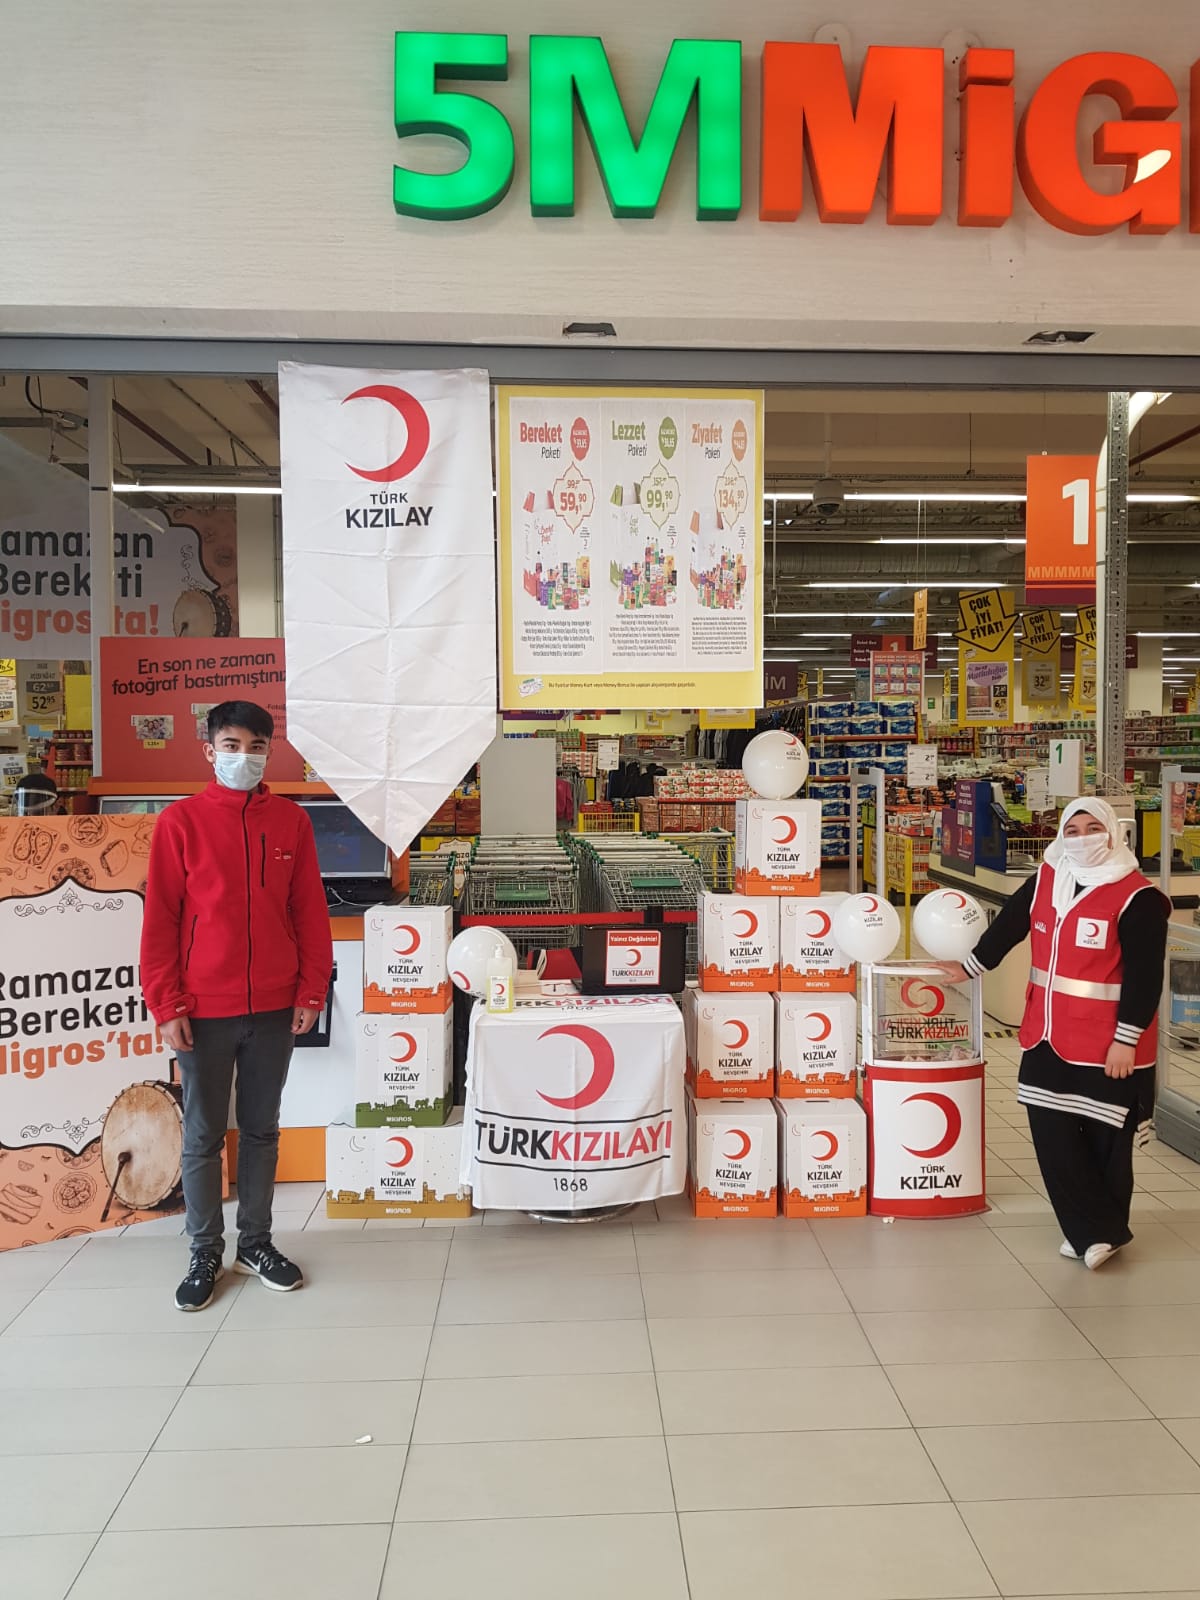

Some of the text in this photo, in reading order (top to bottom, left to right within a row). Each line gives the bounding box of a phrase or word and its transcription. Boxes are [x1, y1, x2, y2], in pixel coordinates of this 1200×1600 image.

[520, 422, 562, 443] Bereket
[612, 420, 646, 440] Lezzet
[691, 422, 722, 447] Ziyafet
[541, 446, 561, 459] Paketi
[628, 444, 647, 456] Paketi
[370, 491, 408, 505] TÜRK
[346, 506, 433, 528] KIZILAY
[1062, 479, 1089, 545] 1
[969, 595, 991, 612] ÇOK
[1029, 614, 1044, 625] ÇOK
[1085, 609, 1096, 620] ÇO
[970, 621, 1004, 640] FİYAT!
[138, 653, 276, 675] En son ne zaman
[112, 675, 179, 696] fotoğraf
[1055, 743, 1062, 764] 1
[767, 852, 800, 862] KIZILAY
[729, 947, 763, 957] KIZILAY
[800, 947, 834, 957] KIZILAY
[387, 965, 424, 975] KIZILAY
[0, 965, 142, 1000] amaza
[803, 1050, 837, 1061] KIZILAY
[718, 1058, 752, 1068] KIZILAY
[384, 1072, 420, 1082] KIZILAY
[715, 1169, 752, 1180] KIZILAY
[807, 1170, 843, 1181] KIZILAY
[920, 1165, 945, 1174] TÜRK
[380, 1177, 416, 1187] KIZILAY
[553, 1178, 588, 1192] 1868
[900, 1174, 963, 1190] KIZILAY
